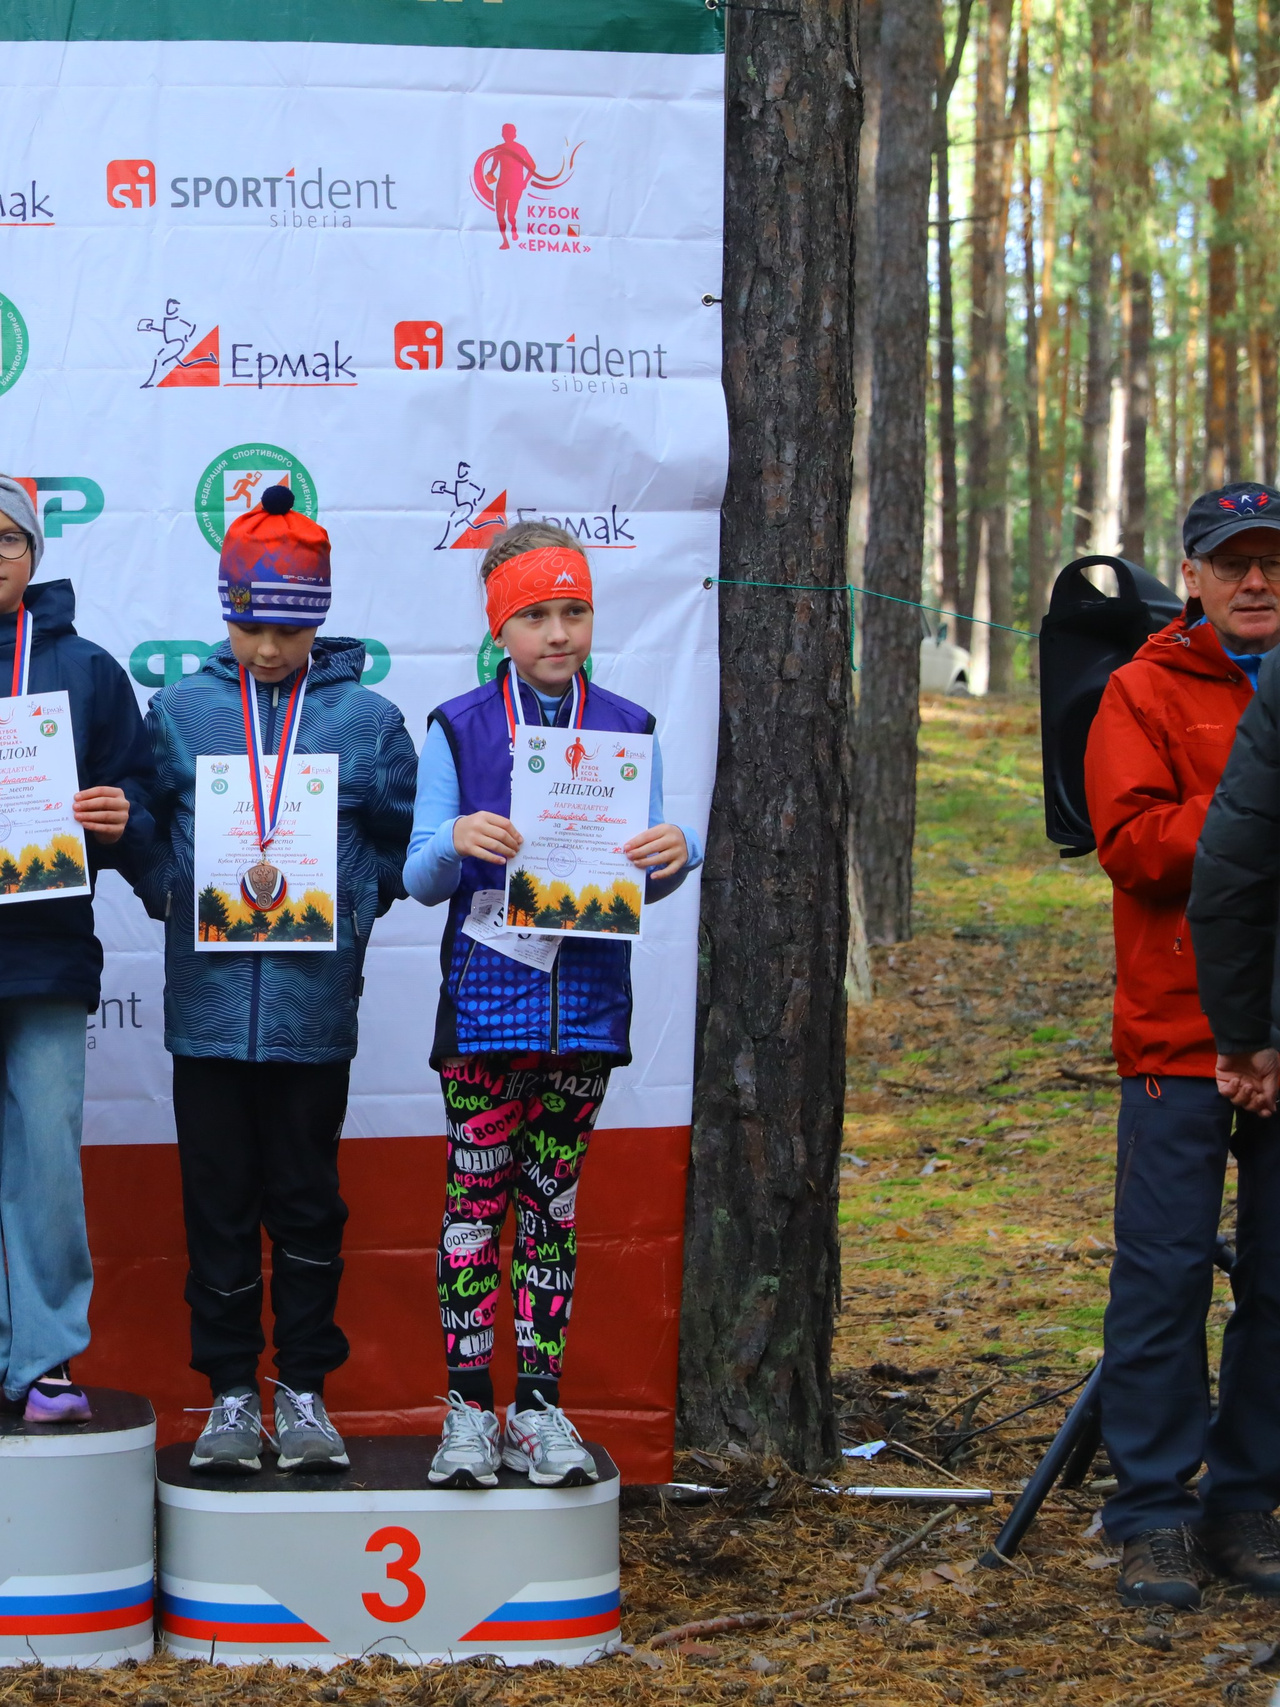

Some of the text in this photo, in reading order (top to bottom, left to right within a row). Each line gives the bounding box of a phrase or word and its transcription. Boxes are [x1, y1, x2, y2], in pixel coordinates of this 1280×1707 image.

[170, 167, 397, 210] SPORTident
[270, 210, 352, 228] siberia
[527, 205, 580, 220] КУБОК
[527, 223, 561, 236] КСО
[518, 239, 591, 254] «ЕРМАК»
[0, 311, 23, 386] ОРИЕНТИРОВАНИЯ
[457, 333, 668, 379] SPORTident
[232, 340, 357, 389] Ермак
[552, 375, 629, 395] siberia
[201, 459, 228, 506] ФЕДЕРАЦИЯ
[232, 449, 293, 468] СПОРТИВНОГО
[42, 705, 64, 715] Ермак
[625, 750, 647, 759] Ермак
[312, 767, 332, 775] Ермак
[549, 782, 615, 798] ДИПЛОМ
[554, 802, 609, 812] НАГРАЖДАЕТСЯ
[580, 824, 605, 832] место
[447, 1080, 493, 1111] love
[444, 1244, 498, 1269] with
[452, 1267, 500, 1297] love
[361, 1526, 426, 1623] 3
